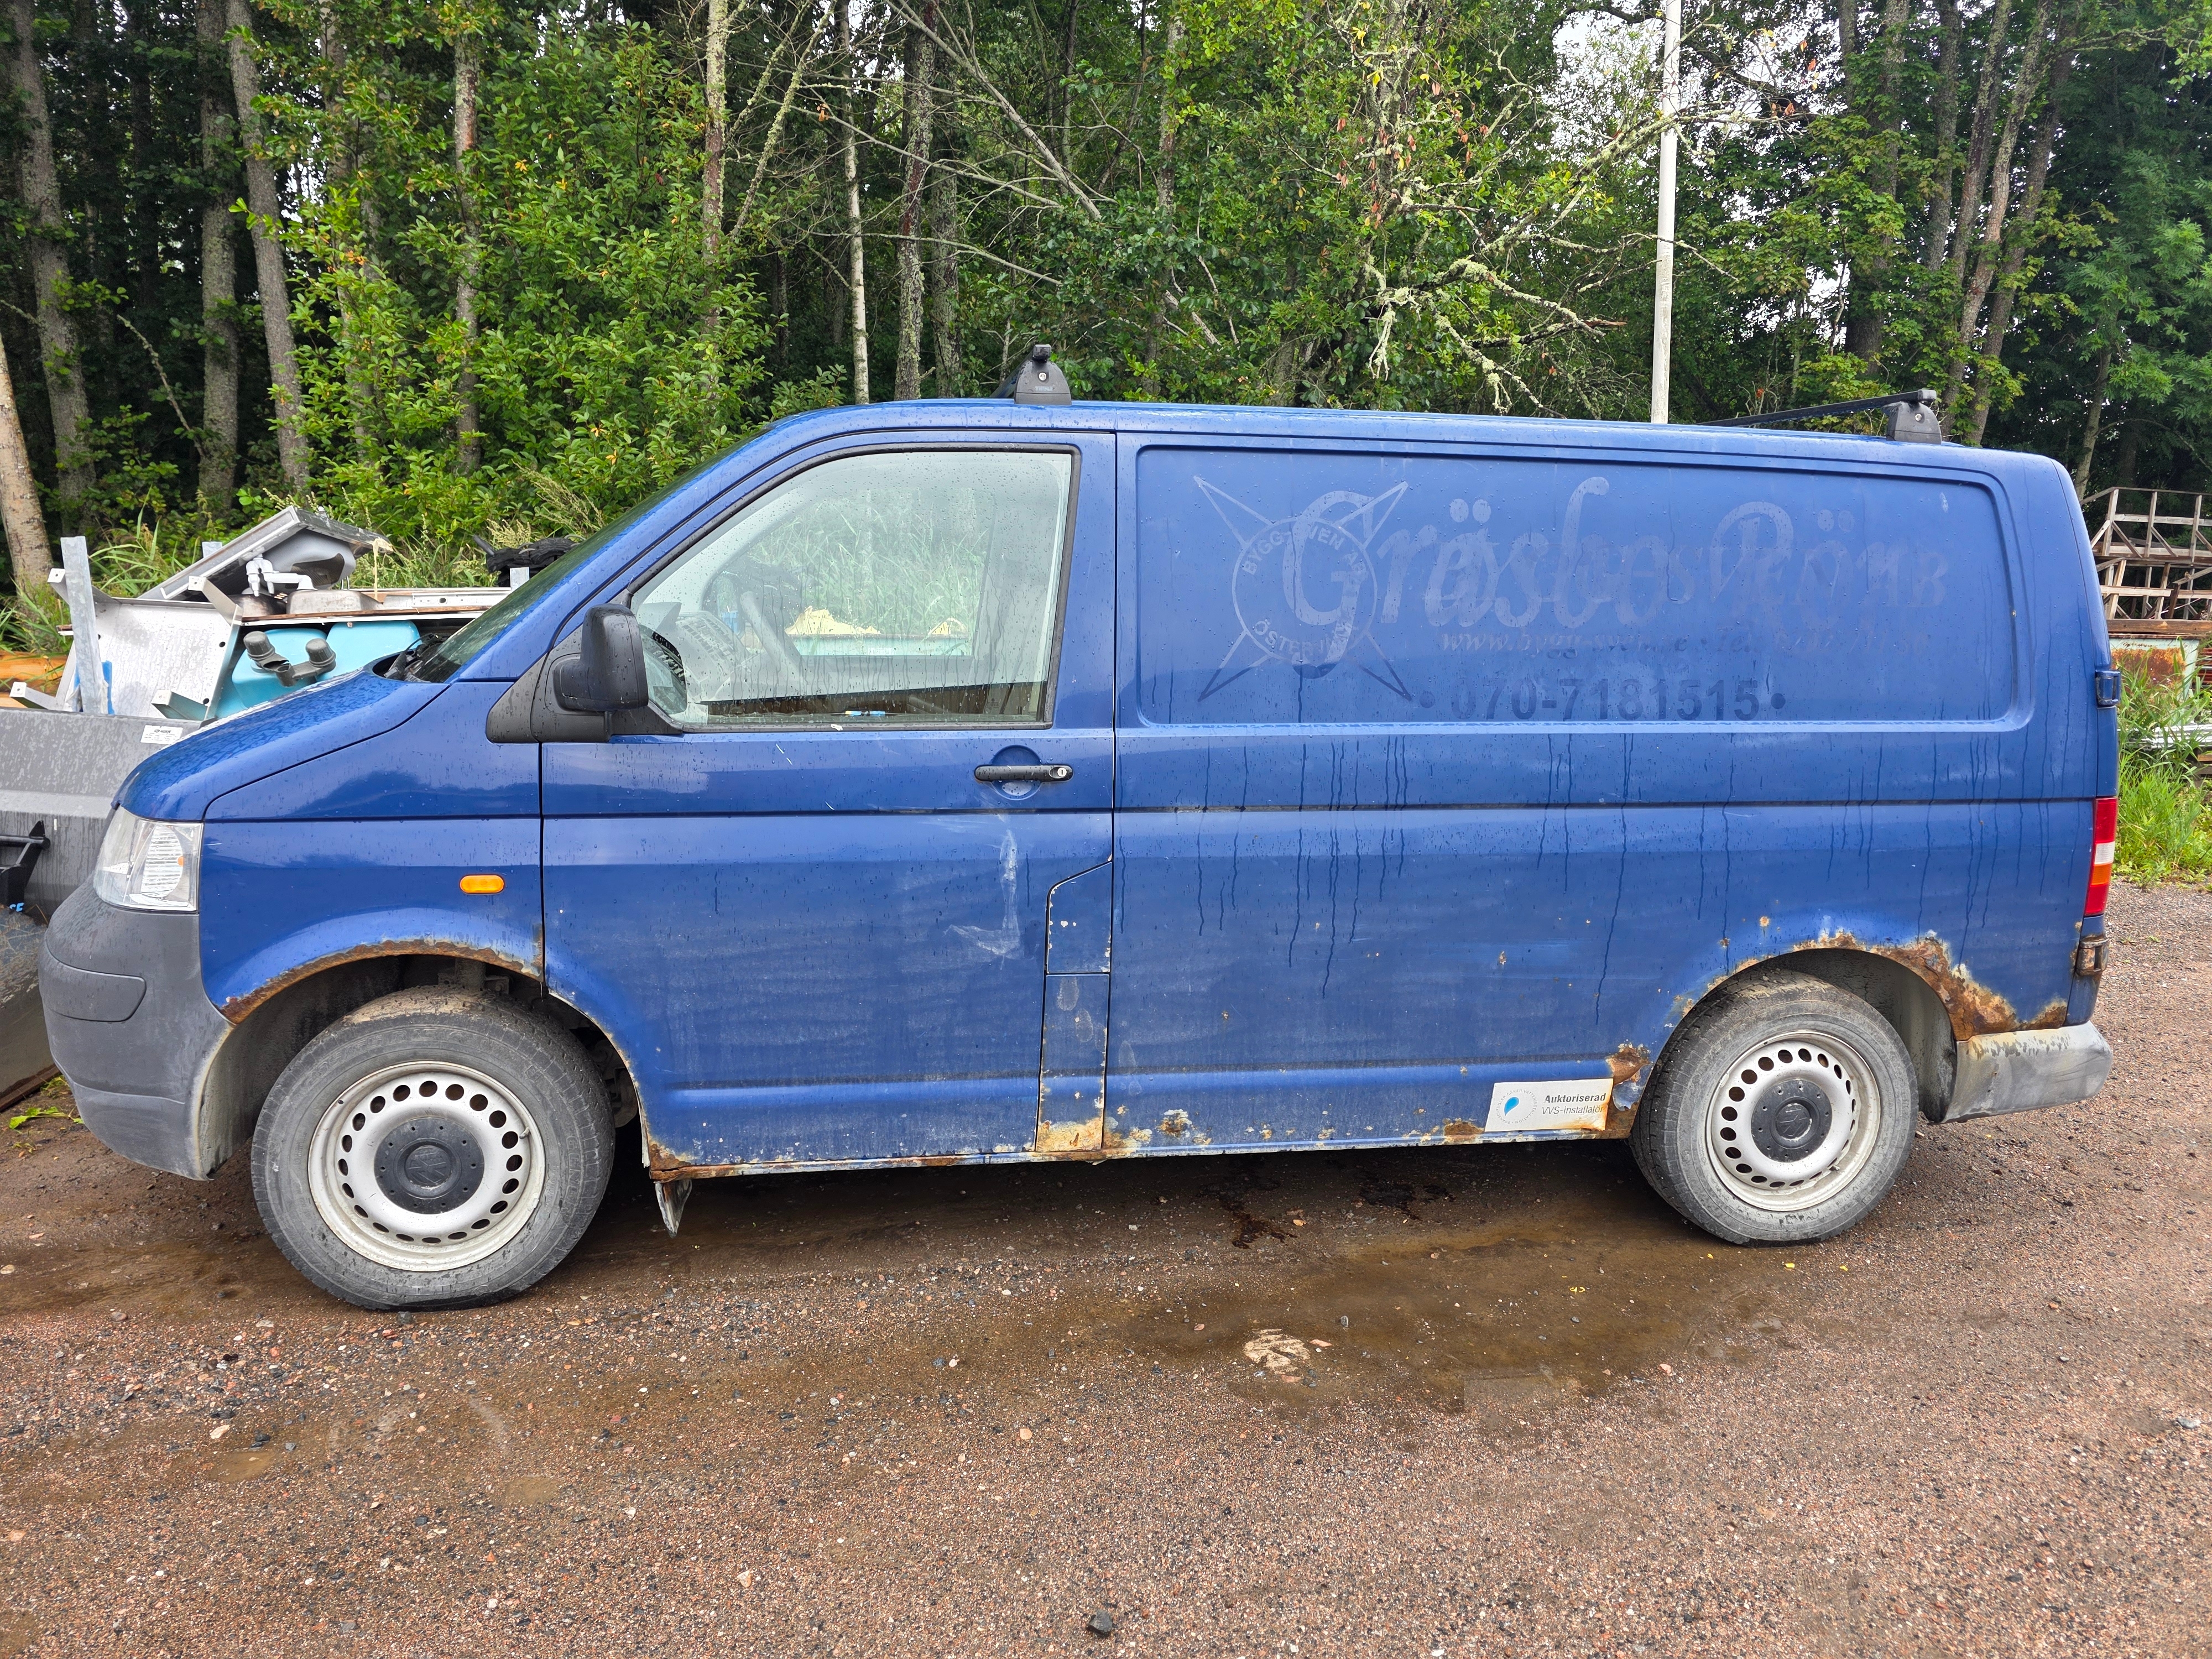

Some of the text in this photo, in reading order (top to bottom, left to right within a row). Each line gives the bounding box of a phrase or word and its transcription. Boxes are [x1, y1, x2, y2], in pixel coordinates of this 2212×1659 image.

[1242, 526, 1344, 575] BYGG-VEN
[1450, 679, 1760, 721] 070-7181515
[1542, 1105, 1603, 1115] VVS-installatör
[1545, 1093, 1606, 1103] Auktoriserad
